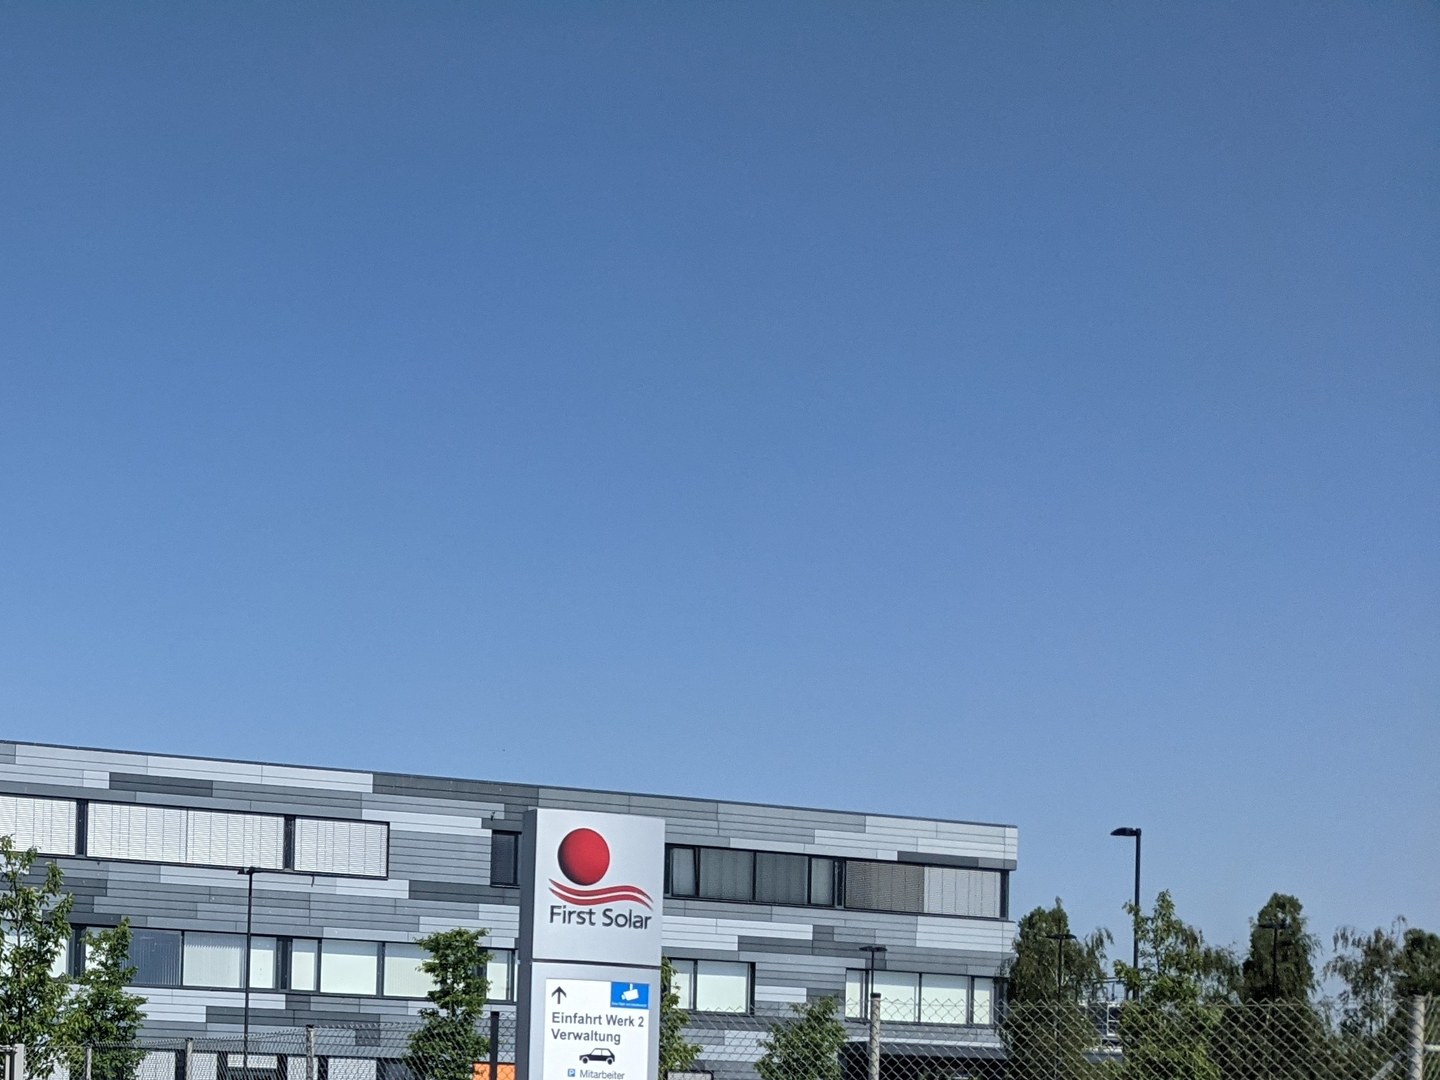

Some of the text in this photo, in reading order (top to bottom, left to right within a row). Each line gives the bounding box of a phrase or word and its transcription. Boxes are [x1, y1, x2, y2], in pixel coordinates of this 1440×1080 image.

[549, 905, 652, 930] First Solar
[551, 1011, 645, 1028] Einfahrt Werk 2
[551, 1028, 621, 1046] Verwaltung
[579, 1069, 625, 1080] Mitarbeiter
